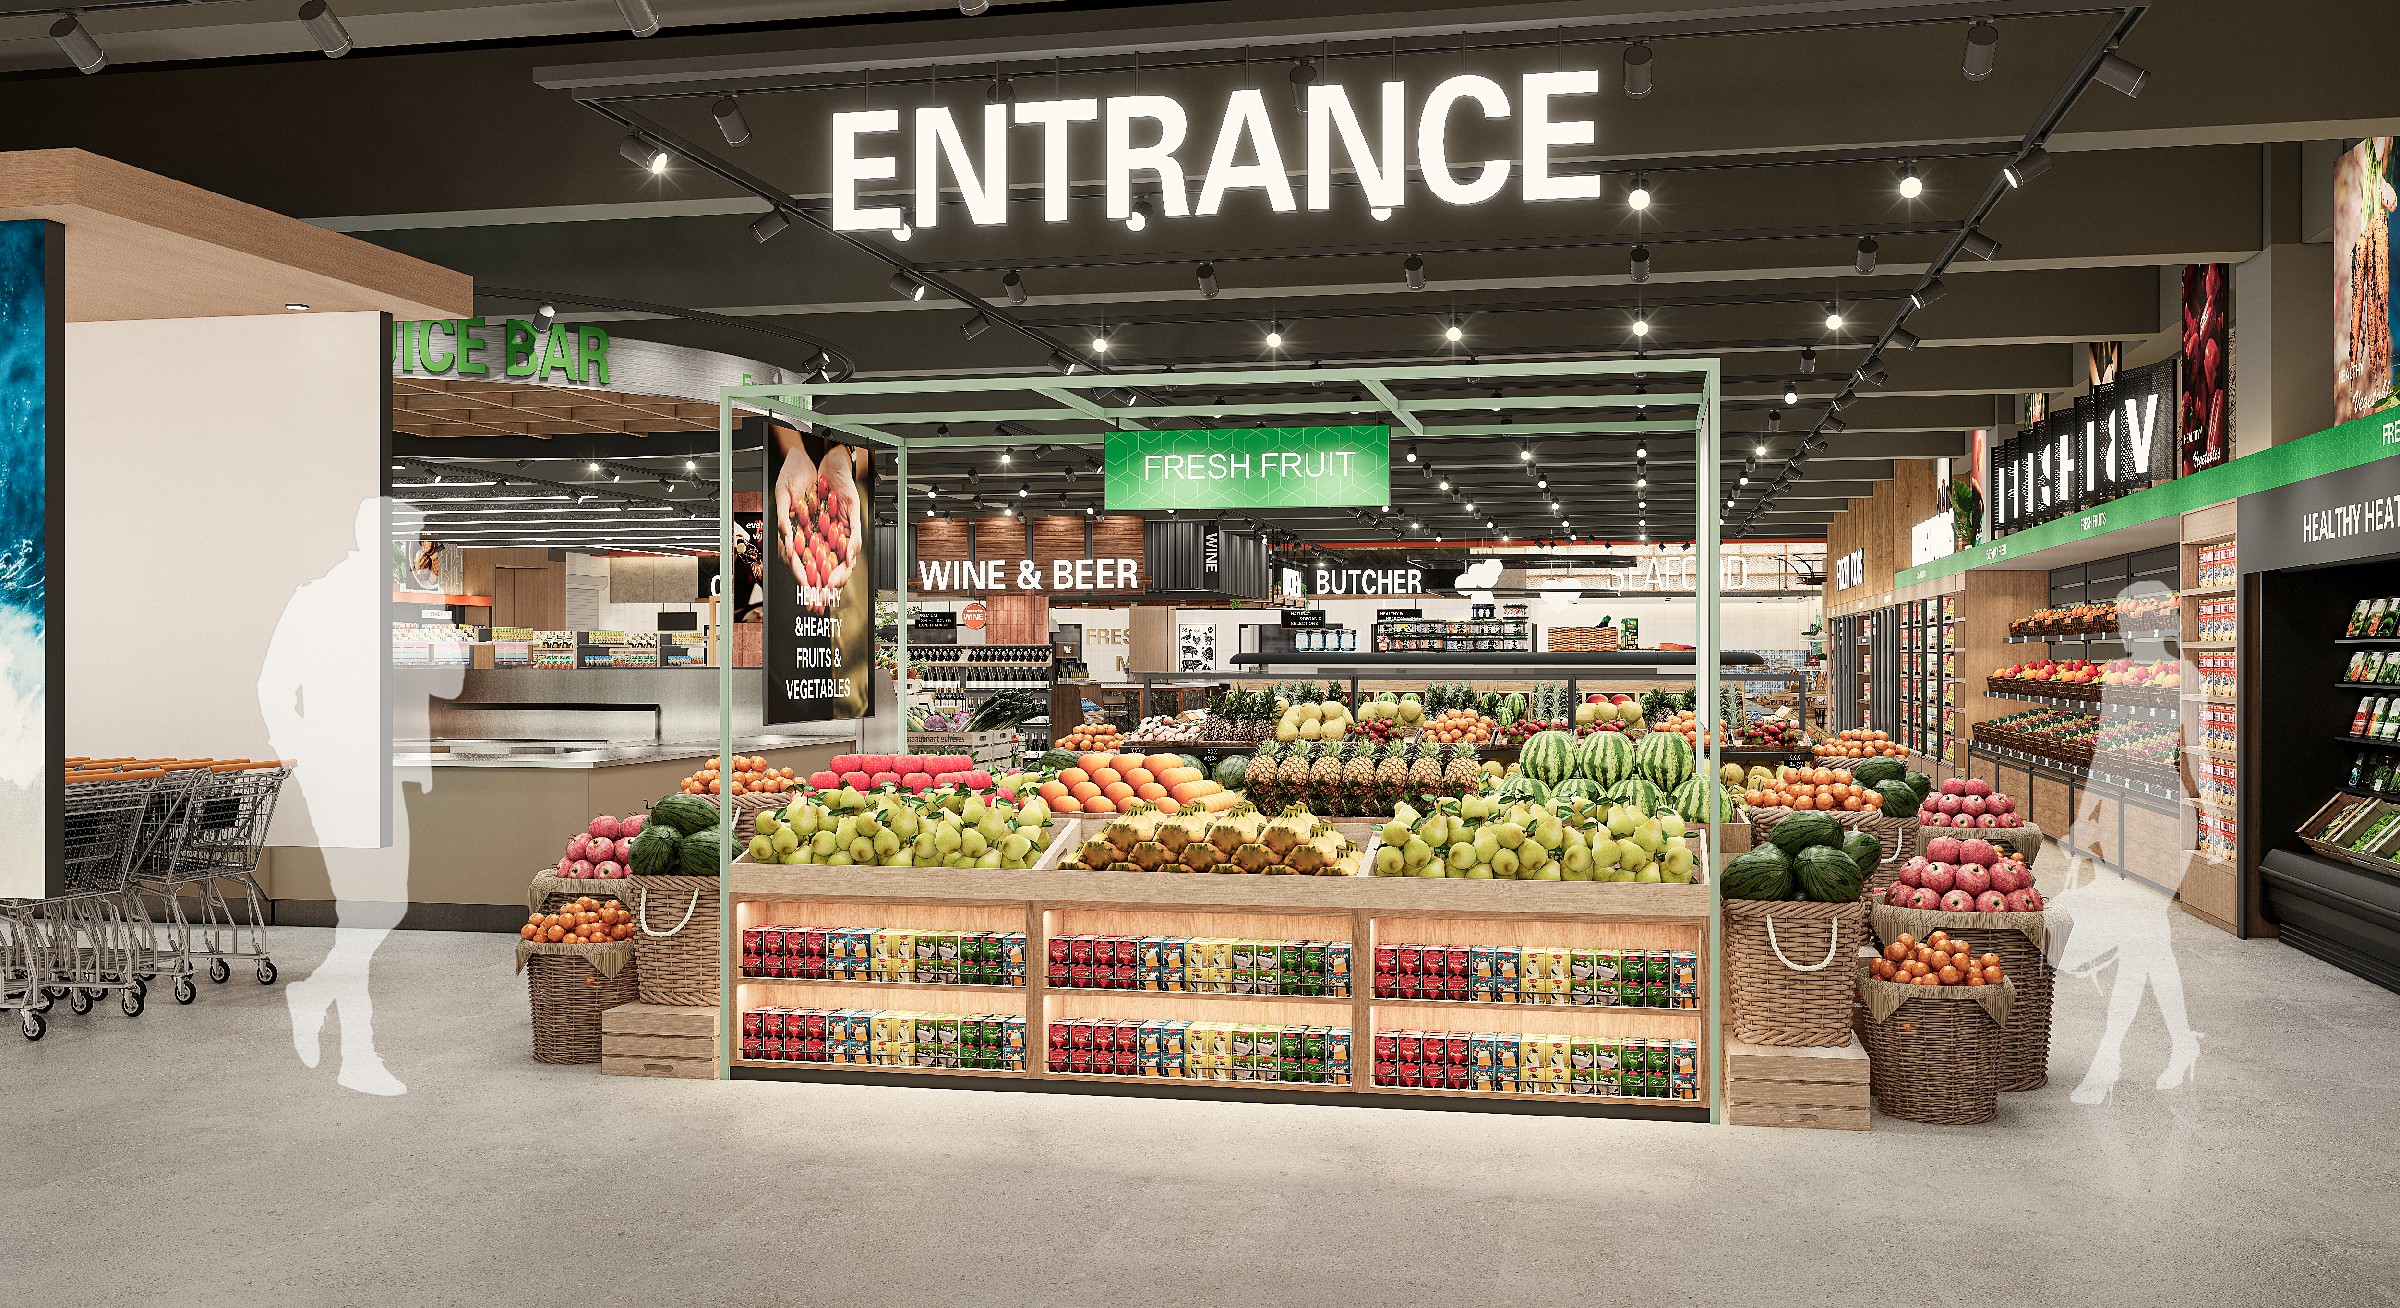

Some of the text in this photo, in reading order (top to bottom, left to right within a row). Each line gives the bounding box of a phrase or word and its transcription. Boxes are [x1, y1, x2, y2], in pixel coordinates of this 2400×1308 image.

[831, 69, 1601, 233] ENTRANCE
[506, 318, 611, 384] BAR
[1144, 451, 1356, 480] FRESH FRUIT
[2303, 503, 2362, 543] HEALTHY
[1205, 532, 1218, 573] WINE
[920, 558, 1139, 591] WINE & BEER
[1316, 569, 1422, 595] BUTCHER
[1606, 556, 1748, 592] SEAFOD
[795, 585, 844, 607] HEALTHY
[794, 616, 843, 638] &HEARTY
[963, 613, 984, 621] WINE
[796, 647, 842, 669] FRUITS &
[785, 677, 851, 700] VEGETABLES
